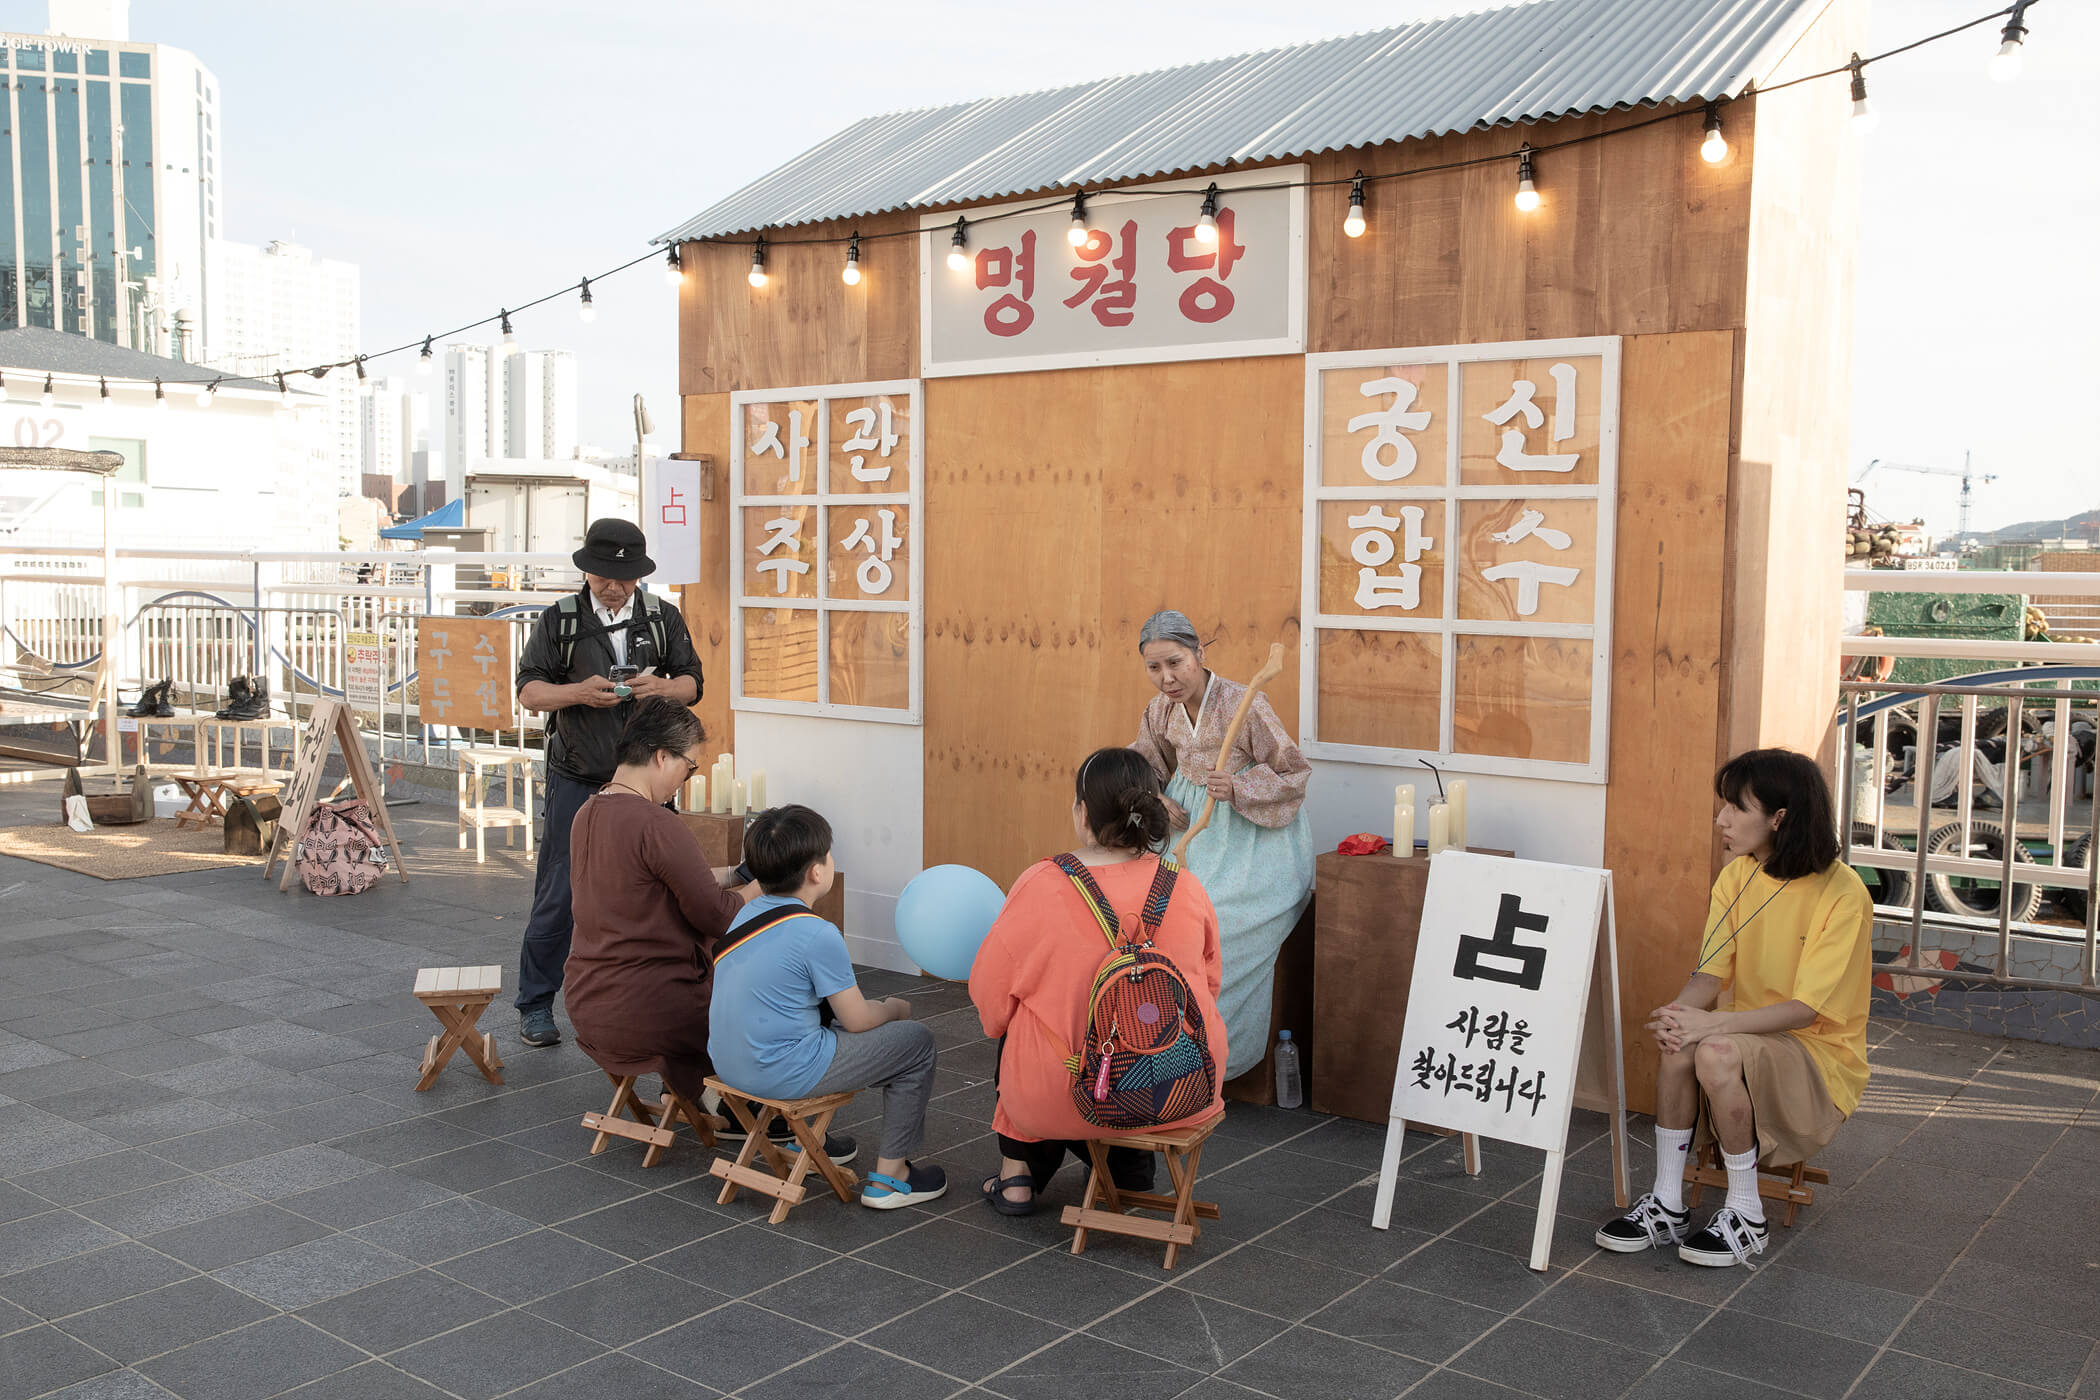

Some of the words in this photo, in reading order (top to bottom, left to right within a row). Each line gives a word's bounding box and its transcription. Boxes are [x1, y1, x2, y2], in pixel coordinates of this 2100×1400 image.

[36, 39, 93, 56] TOWER
[974, 206, 1246, 338] 명월당
[750, 409, 810, 594] 사주
[840, 402, 902, 595] 관상
[1347, 376, 1433, 610] 궁합
[429, 631, 454, 718] 구두
[472, 633, 499, 717] 수선
[285, 767, 311, 823] 보이
[1453, 893, 1549, 991] 占
[1446, 1006, 1533, 1055] 사람을
[1410, 1046, 1547, 1117] 찾아드립니다
